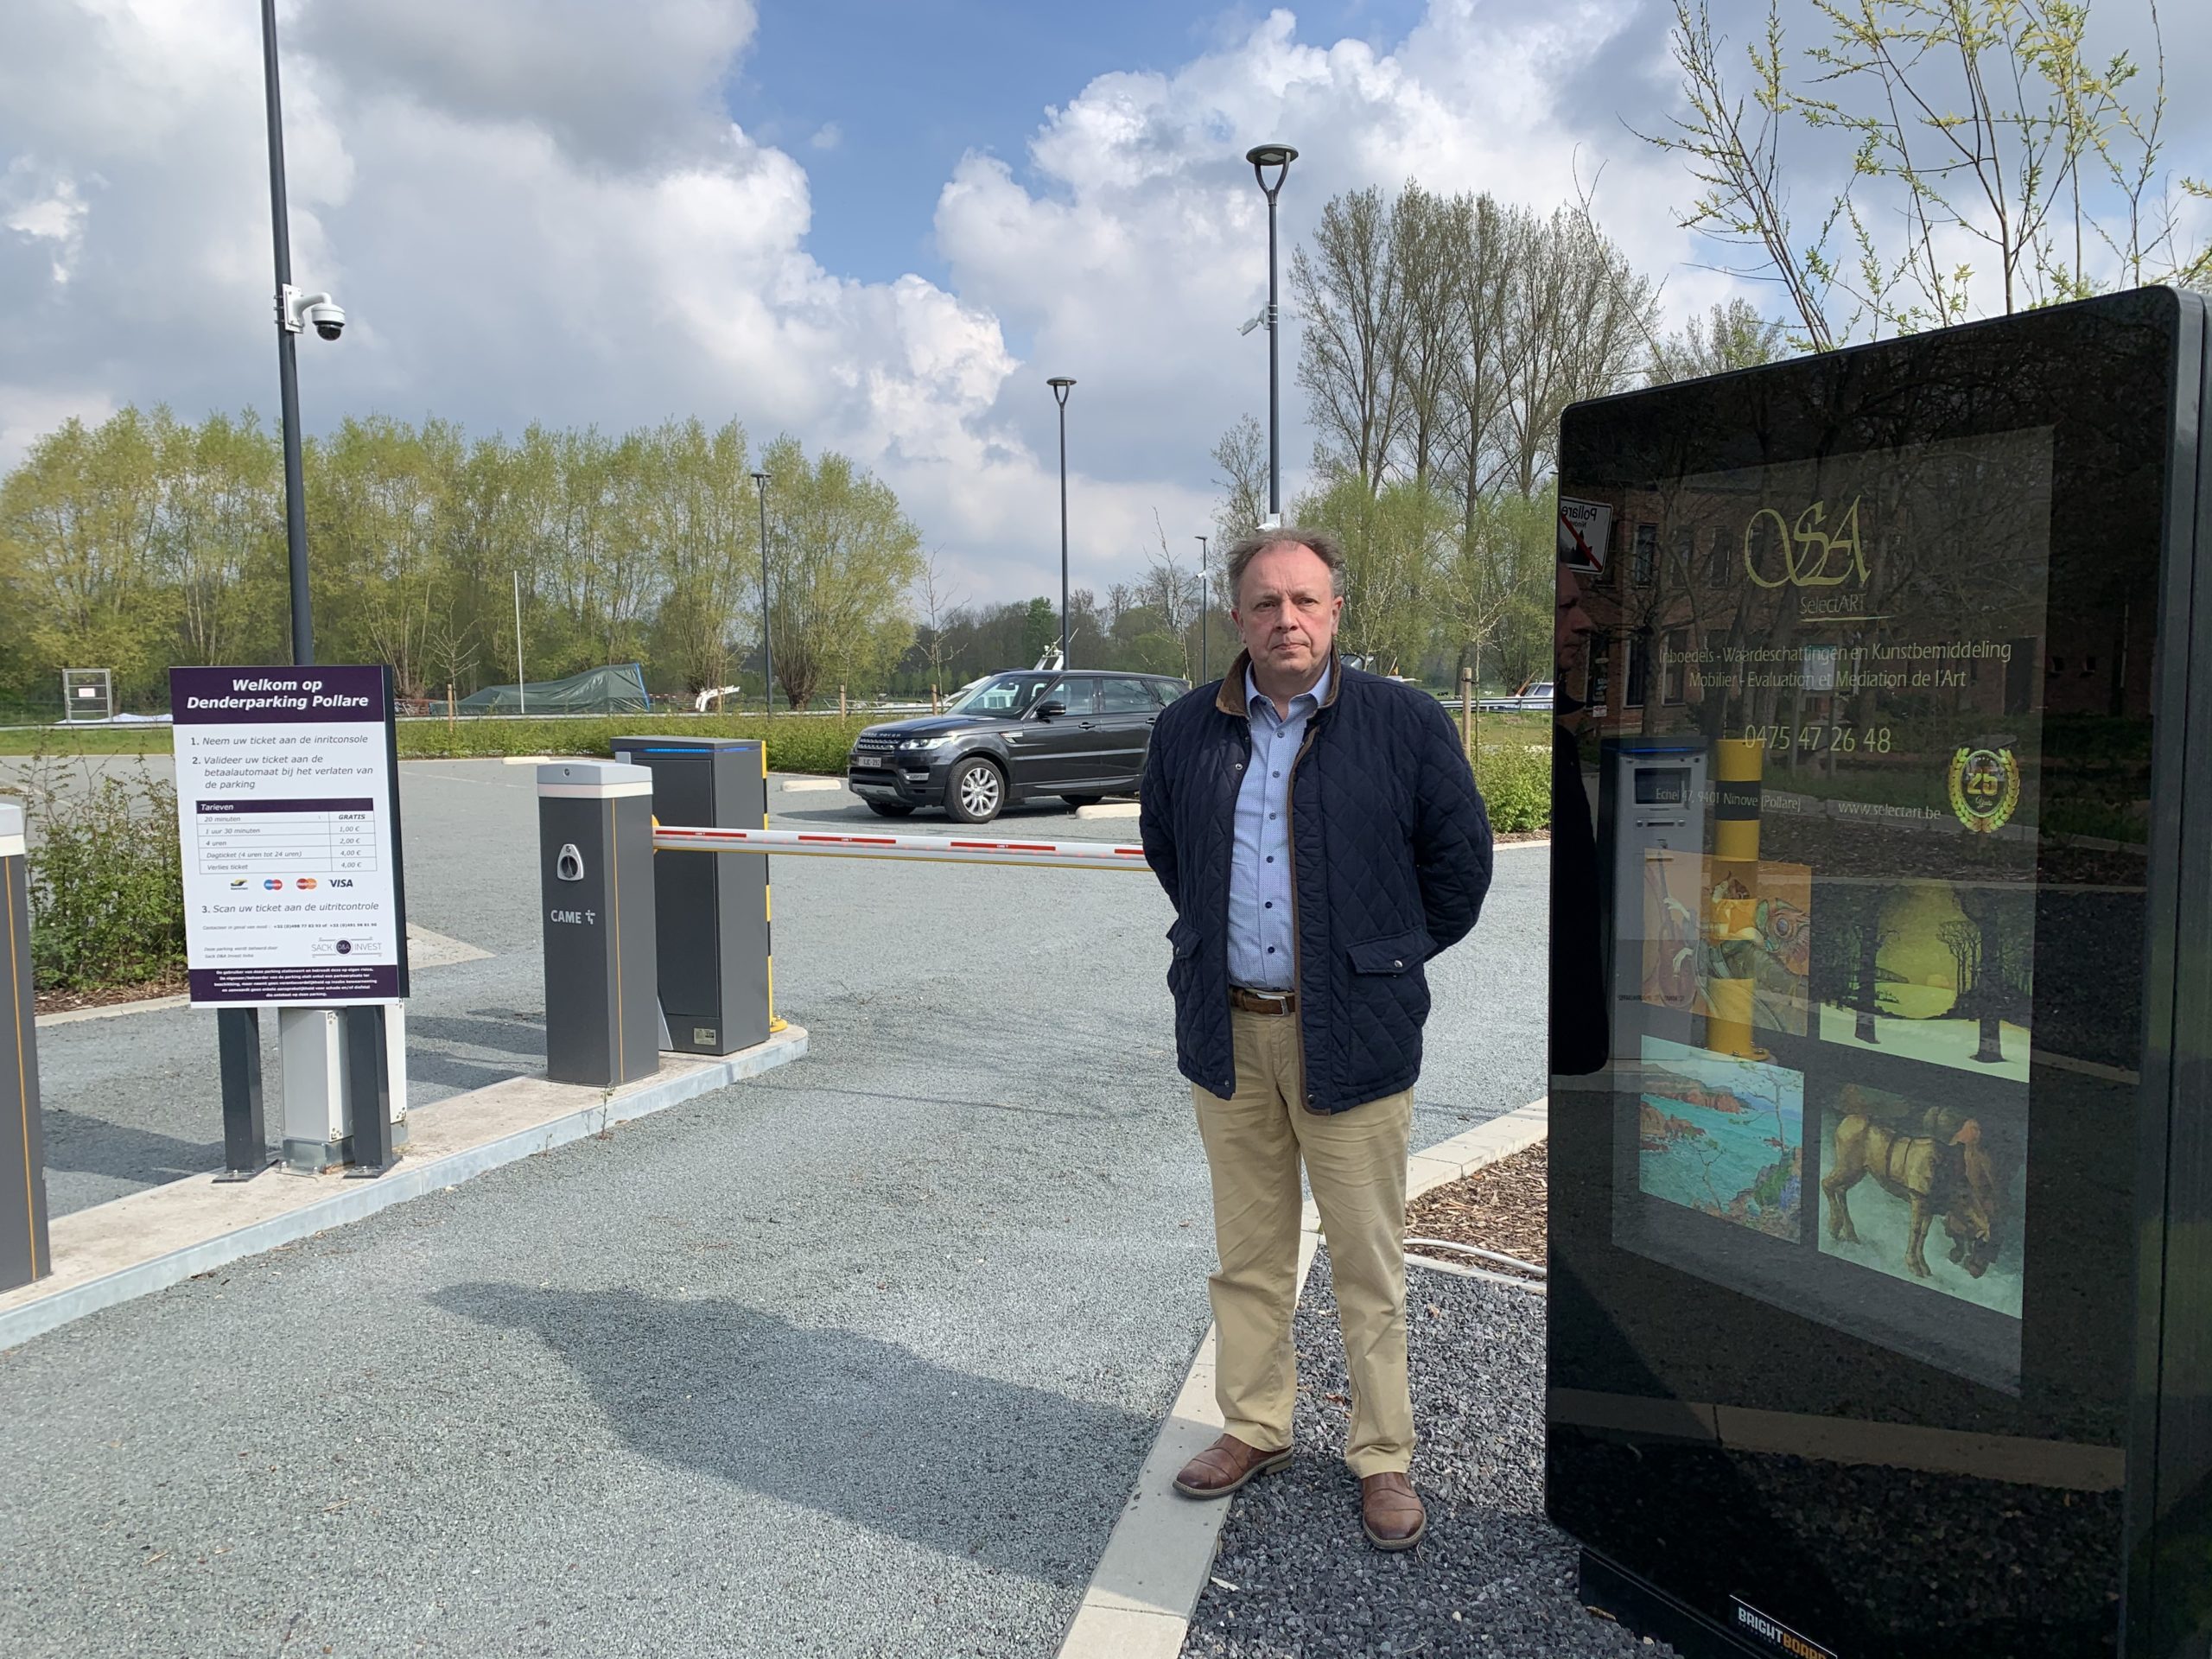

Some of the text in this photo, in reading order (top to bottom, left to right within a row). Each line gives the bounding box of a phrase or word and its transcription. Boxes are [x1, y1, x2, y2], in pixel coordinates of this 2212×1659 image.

[1800, 593, 1866, 614] SelectART
[1659, 647, 1714, 664] Inboedels
[1723, 645, 1847, 665] Waardeschattingen
[1851, 646, 1868, 660] en
[1872, 640, 2012, 663] Kunstbemiddeling
[232, 678, 322, 693] Welkom op
[1689, 671, 1738, 687] Mobilier
[1747, 671, 1815, 688] Evaluation
[1818, 673, 1832, 687] et
[1836, 670, 1907, 688] Mediation
[1912, 670, 1931, 687] de
[1936, 669, 1967, 687] l'Art
[187, 694, 369, 710] Denderparking Pollare
[191, 737, 200, 746] 1.
[250, 736, 276, 745] ticket
[299, 735, 311, 744] de
[314, 734, 368, 744] inritconsole
[1745, 724, 1891, 753] 0475 47 26 48
[192, 756, 201, 765] 2.
[204, 756, 243, 765] Valideer
[262, 755, 289, 764] ticket
[311, 754, 323, 763] de
[204, 767, 279, 777] betaalautomaat
[282, 766, 294, 777] bij
[296, 766, 312, 775] het
[315, 766, 353, 775] verlaten
[205, 780, 256, 790] de parking
[1967, 772, 1999, 796] 25
[1656, 788, 1680, 801] Echel
[1697, 791, 1719, 804] 9401
[1723, 792, 1759, 807] Ninove
[200, 803, 234, 811] Tarieven
[1838, 801, 1942, 820] www.selectart.be
[329, 879, 353, 887] VISA
[201, 905, 210, 913] 3.
[213, 905, 236, 913] Scan
[256, 904, 282, 912] ticket
[304, 902, 316, 911] de
[319, 902, 379, 911] uitritcontrole
[550, 909, 582, 924] CAME
[311, 944, 333, 952] SACK
